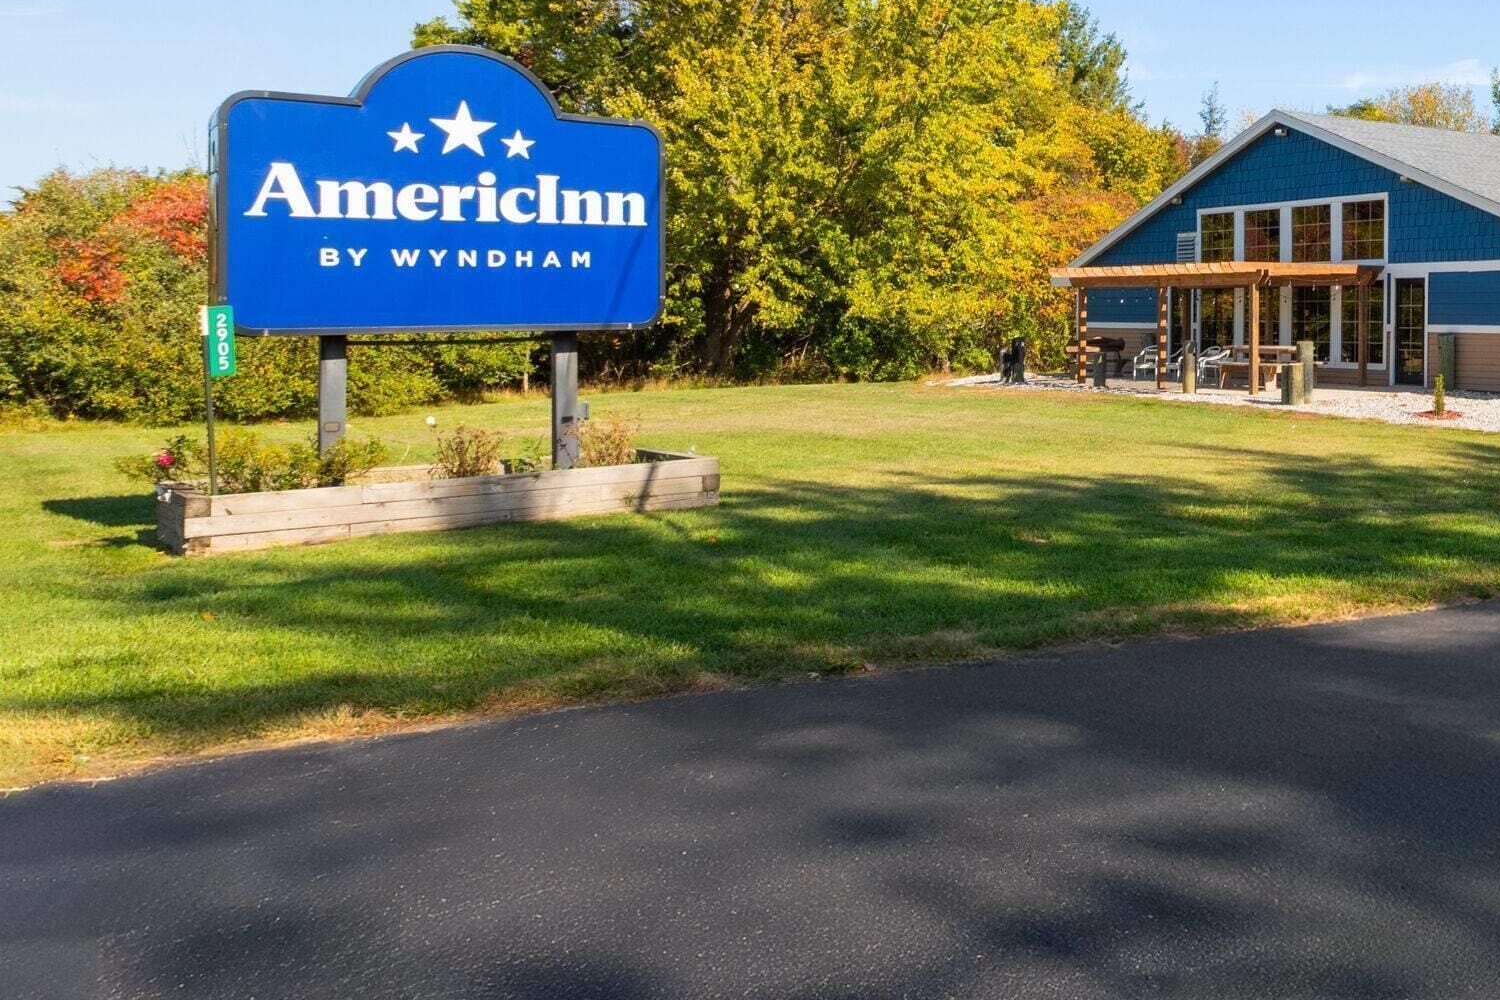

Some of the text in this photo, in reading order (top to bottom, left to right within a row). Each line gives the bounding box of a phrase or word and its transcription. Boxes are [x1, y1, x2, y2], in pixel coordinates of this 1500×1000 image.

[243, 161, 648, 227] AmericInn
[319, 248, 593, 269] BY WYNDHAM
[215, 313, 231, 371] 2905
